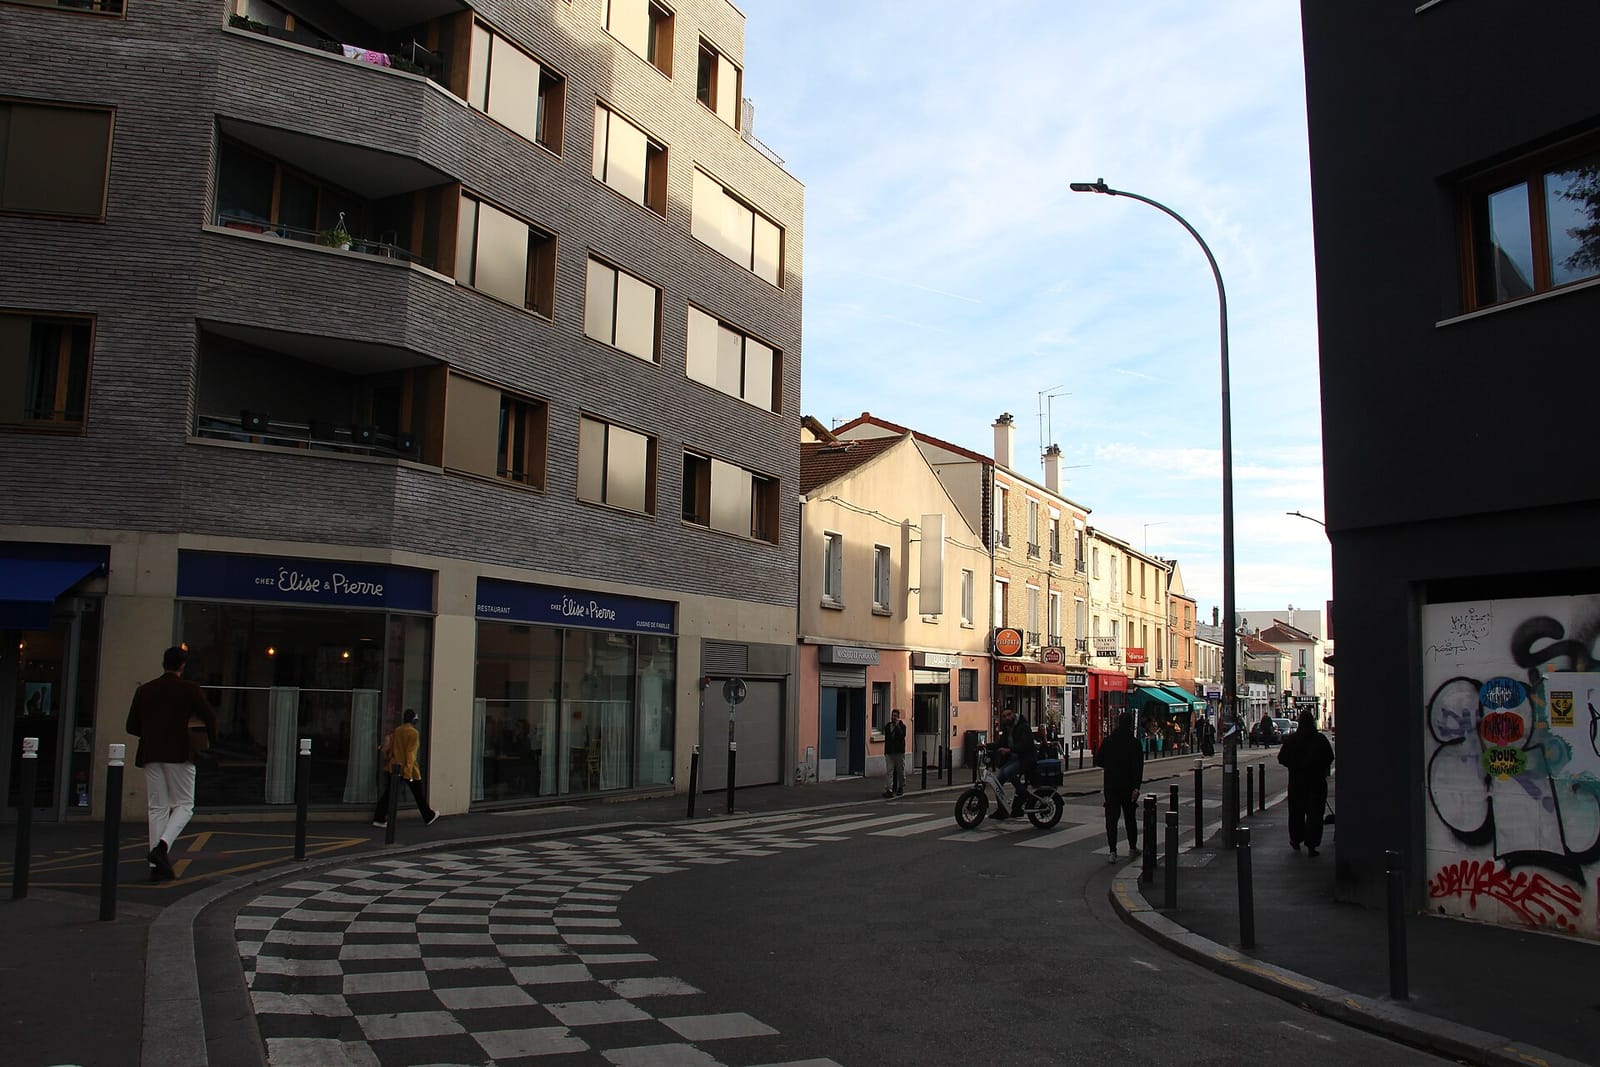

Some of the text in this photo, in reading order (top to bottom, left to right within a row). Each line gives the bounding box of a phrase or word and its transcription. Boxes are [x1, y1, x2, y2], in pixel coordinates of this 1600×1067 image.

[278, 567, 320, 592] Élise
[332, 573, 384, 597] Pierre
[477, 604, 511, 614] RESTAURANT
[551, 603, 562, 611] CHEZ
[562, 595, 585, 617] Élise
[589, 600, 616, 621] Pierre
[1489, 749, 1519, 762] JOUR
